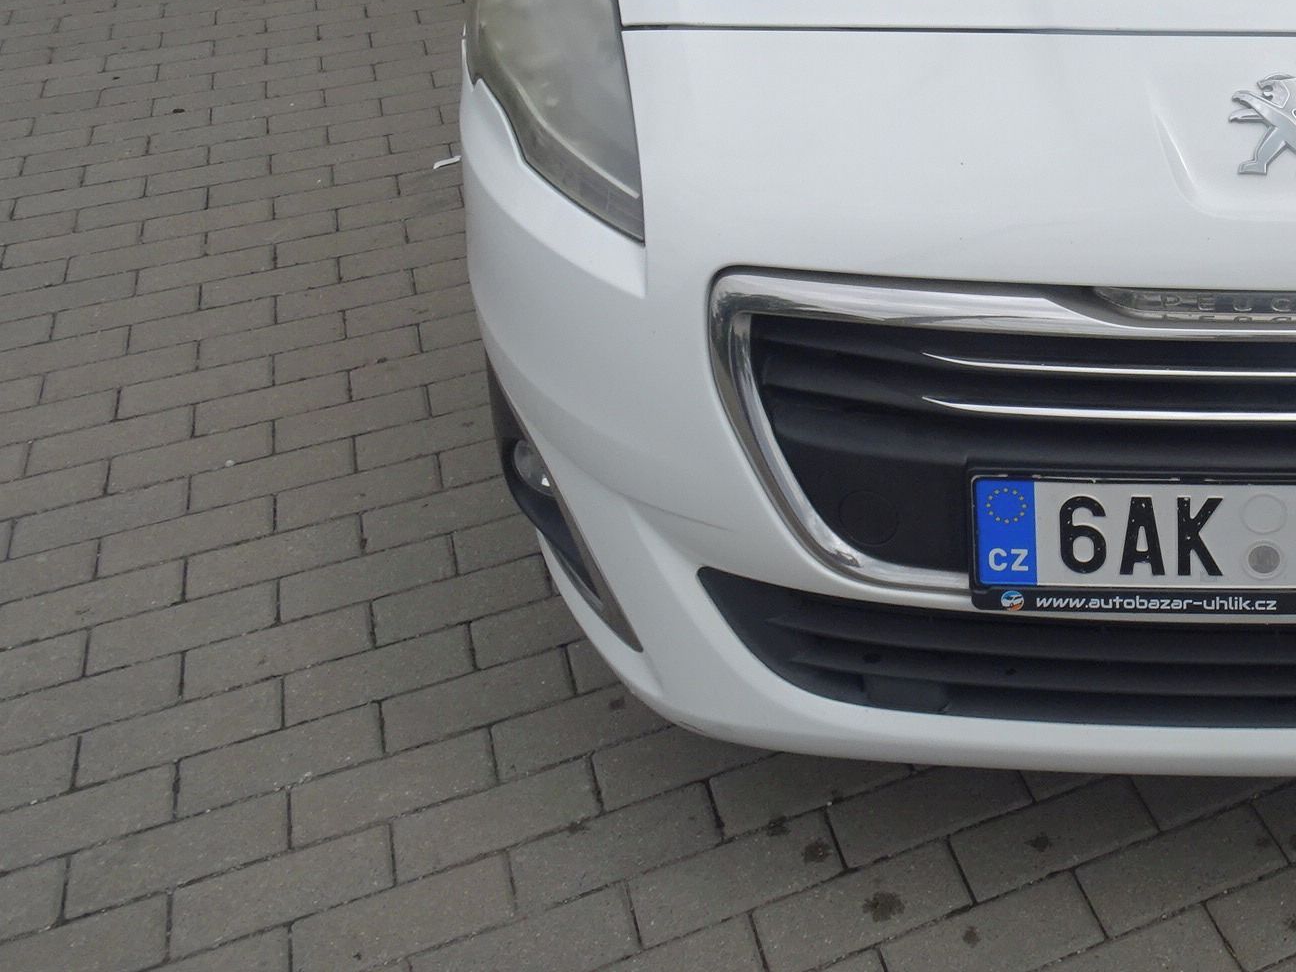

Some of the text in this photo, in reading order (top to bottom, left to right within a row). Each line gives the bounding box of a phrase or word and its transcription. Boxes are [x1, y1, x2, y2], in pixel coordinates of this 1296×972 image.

[1059, 496, 1224, 577] 6AK
[988, 547, 1029, 572] CZ
[1036, 595, 1277, 612] www.autobazar-uhlik.cz
